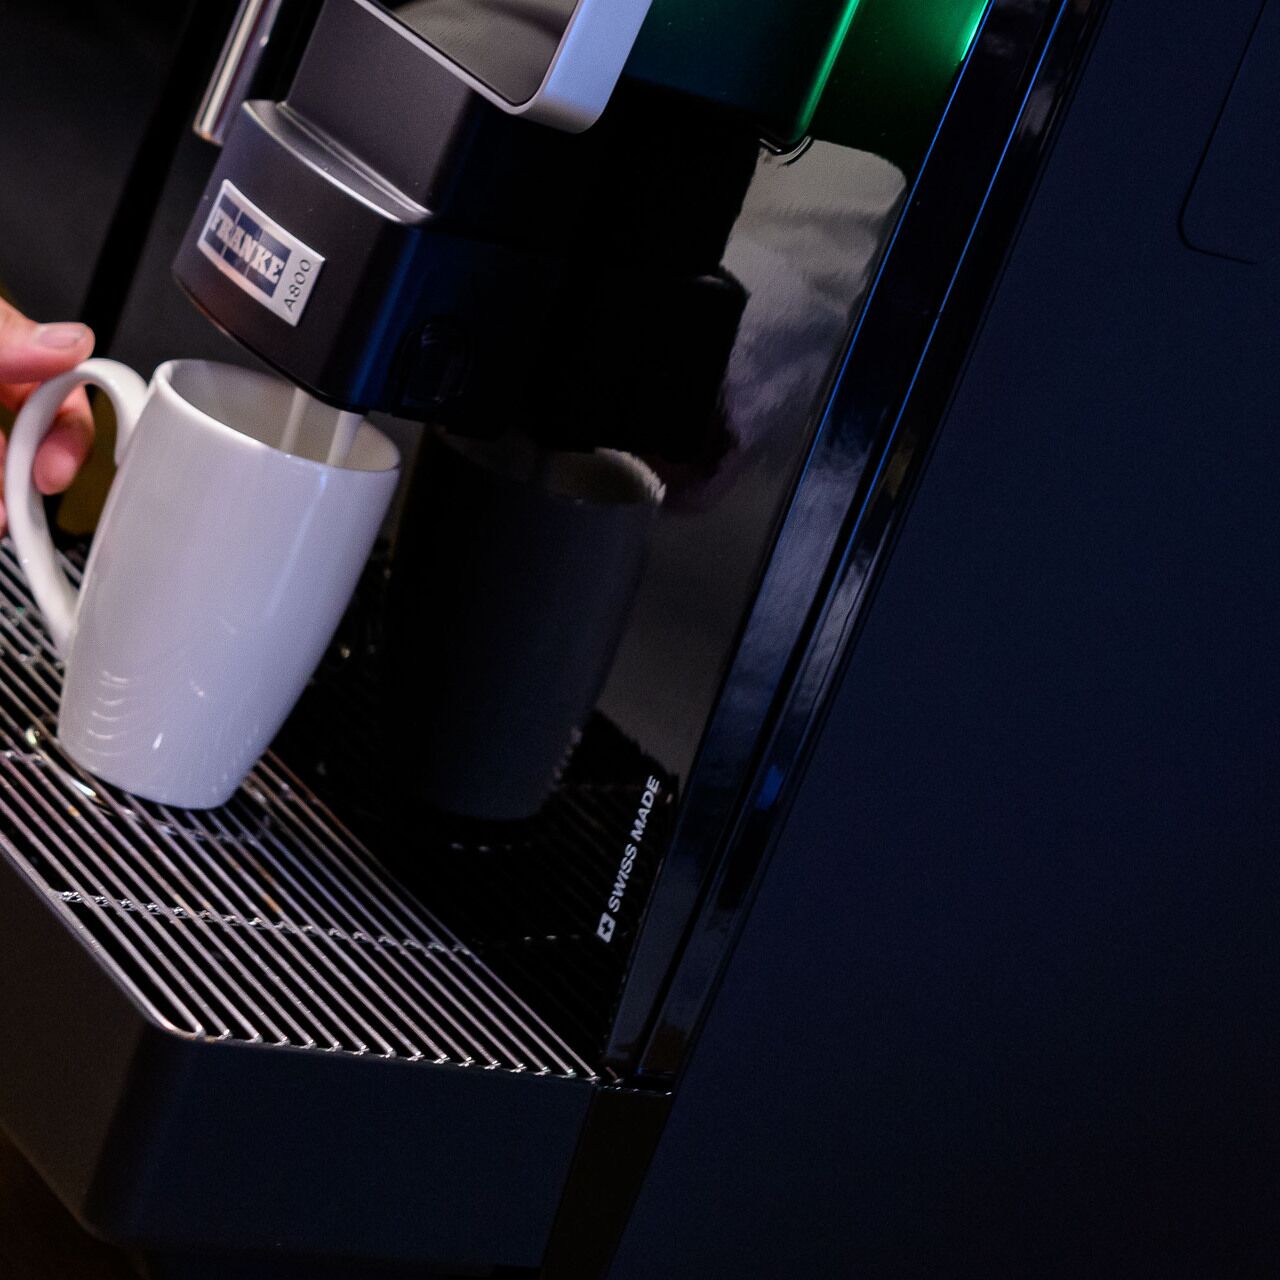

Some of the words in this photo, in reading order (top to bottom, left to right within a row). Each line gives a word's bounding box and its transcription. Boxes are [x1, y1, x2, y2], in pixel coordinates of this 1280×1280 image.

[209, 205, 287, 284] FRANKE
[283, 259, 311, 312] A800
[607, 843, 638, 913] SWISS
[630, 775, 660, 842] MADE
